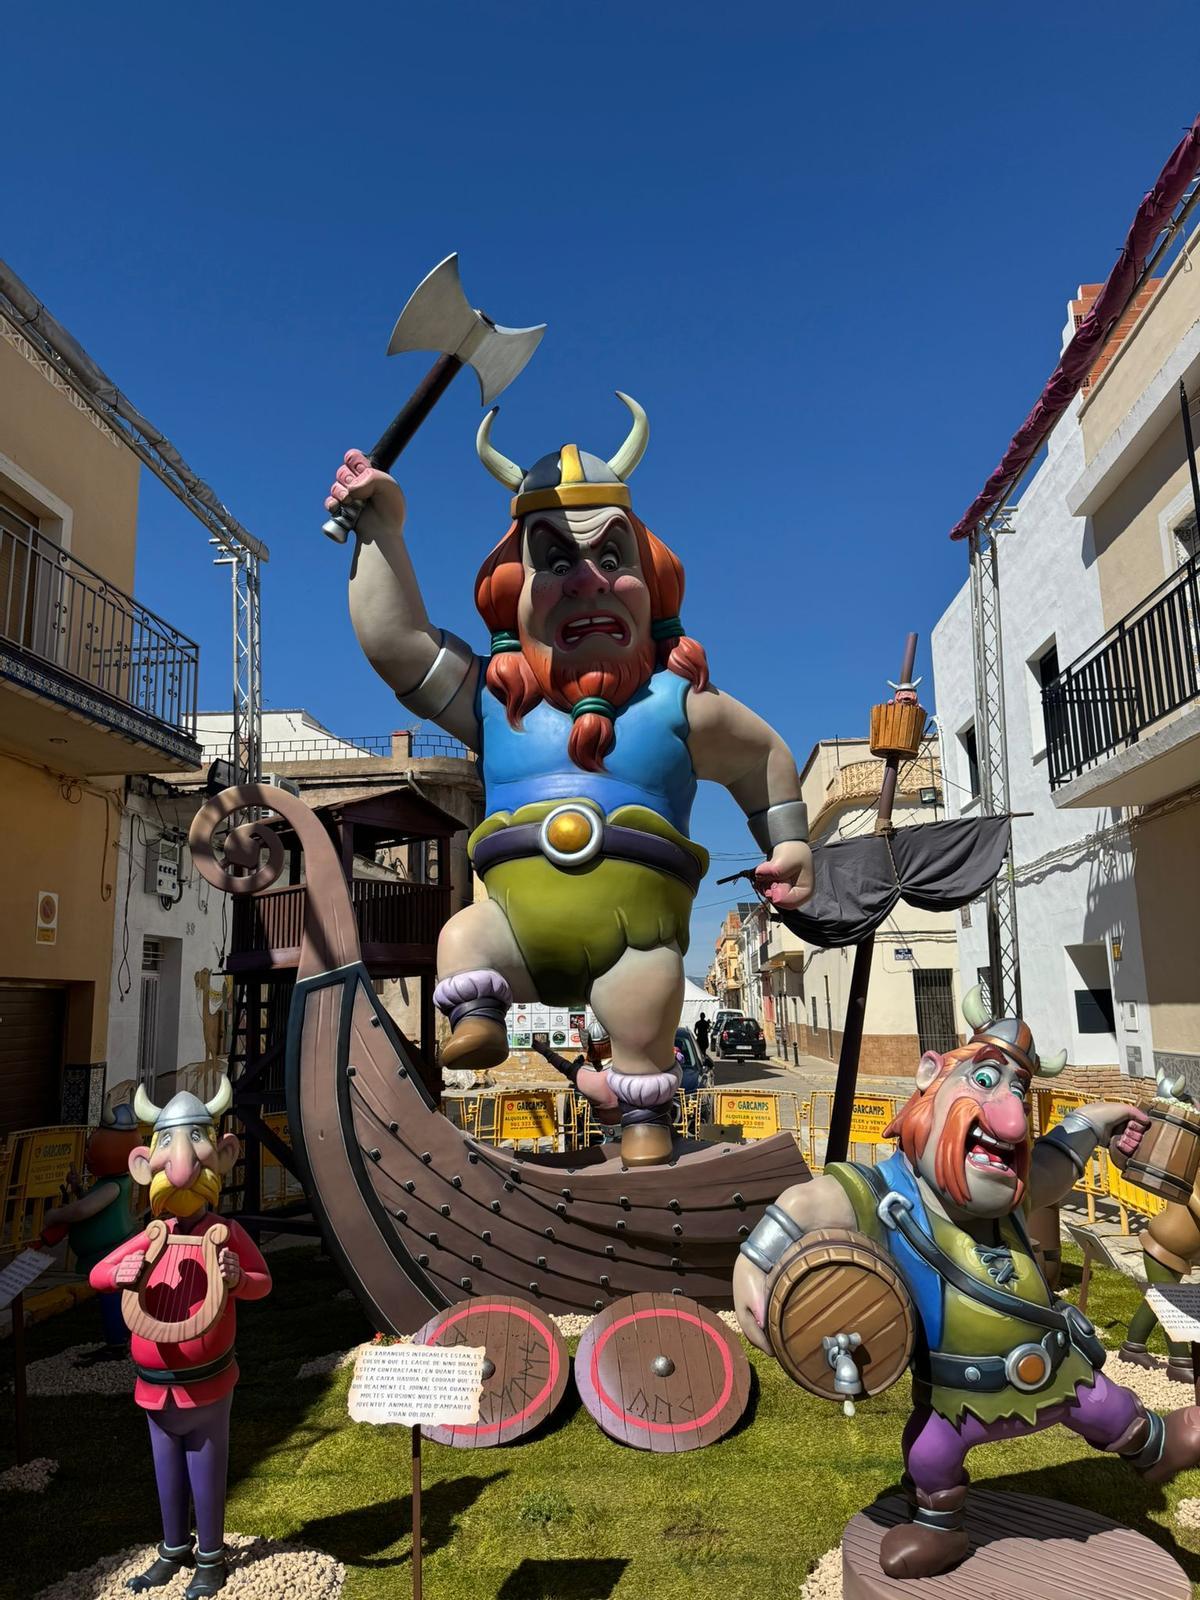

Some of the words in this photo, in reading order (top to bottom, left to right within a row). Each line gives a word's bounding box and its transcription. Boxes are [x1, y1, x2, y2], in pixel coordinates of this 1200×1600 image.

[517, 1101, 547, 1110] GARCAMPS
[737, 1100, 769, 1111] GARCAMPS
[852, 1104, 884, 1115] GARCAMPS
